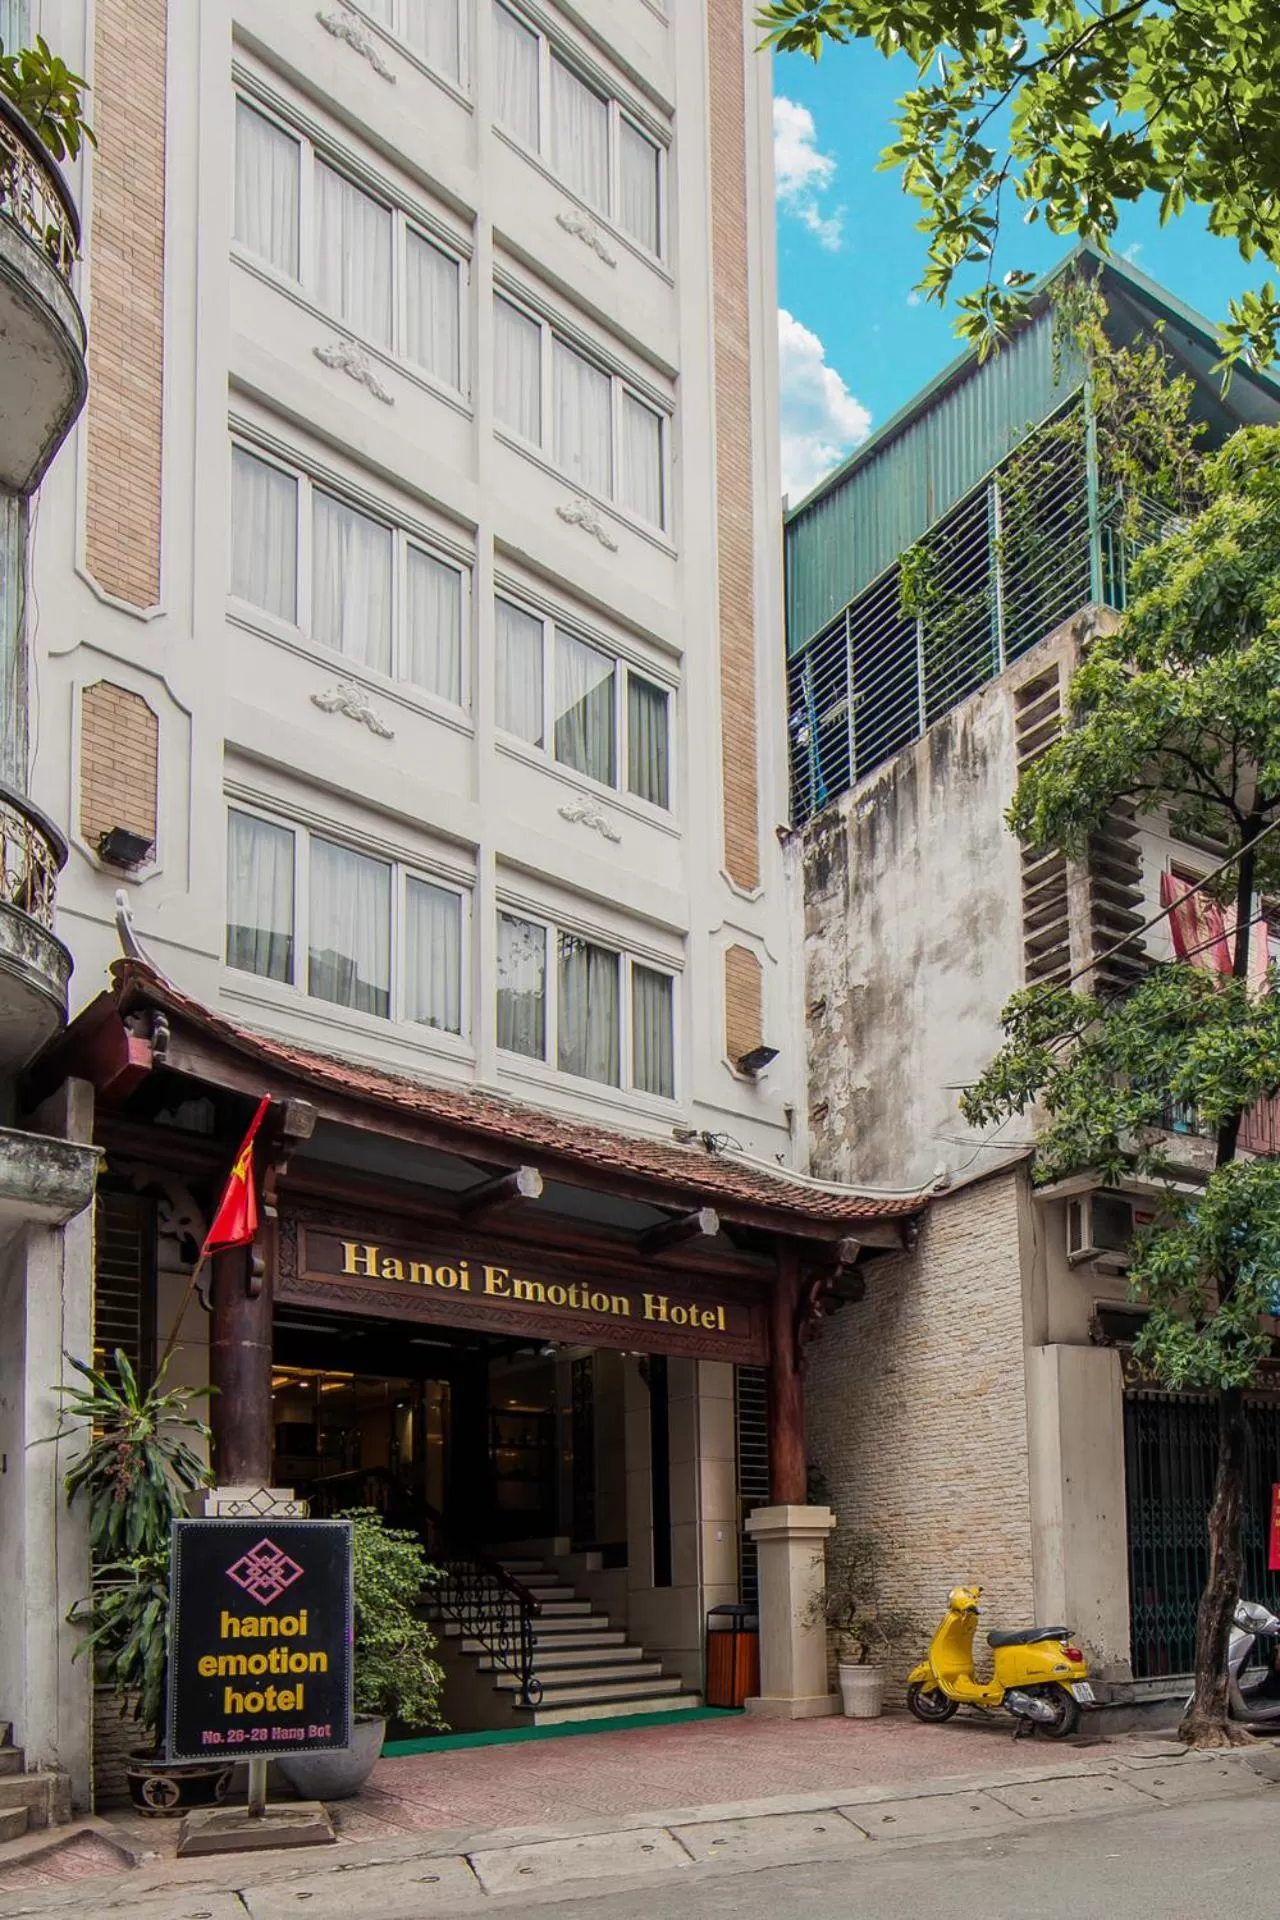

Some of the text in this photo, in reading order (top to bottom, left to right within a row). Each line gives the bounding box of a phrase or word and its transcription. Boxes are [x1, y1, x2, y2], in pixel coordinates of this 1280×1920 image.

[340, 1241, 727, 1331] Hanoi Emotion Hotel
[220, 1609, 308, 1638] hanoi
[198, 1646, 328, 1677] emotion
[224, 1683, 305, 1714] hotel
[202, 1731, 225, 1744] No.
[272, 1727, 305, 1740] Hang
